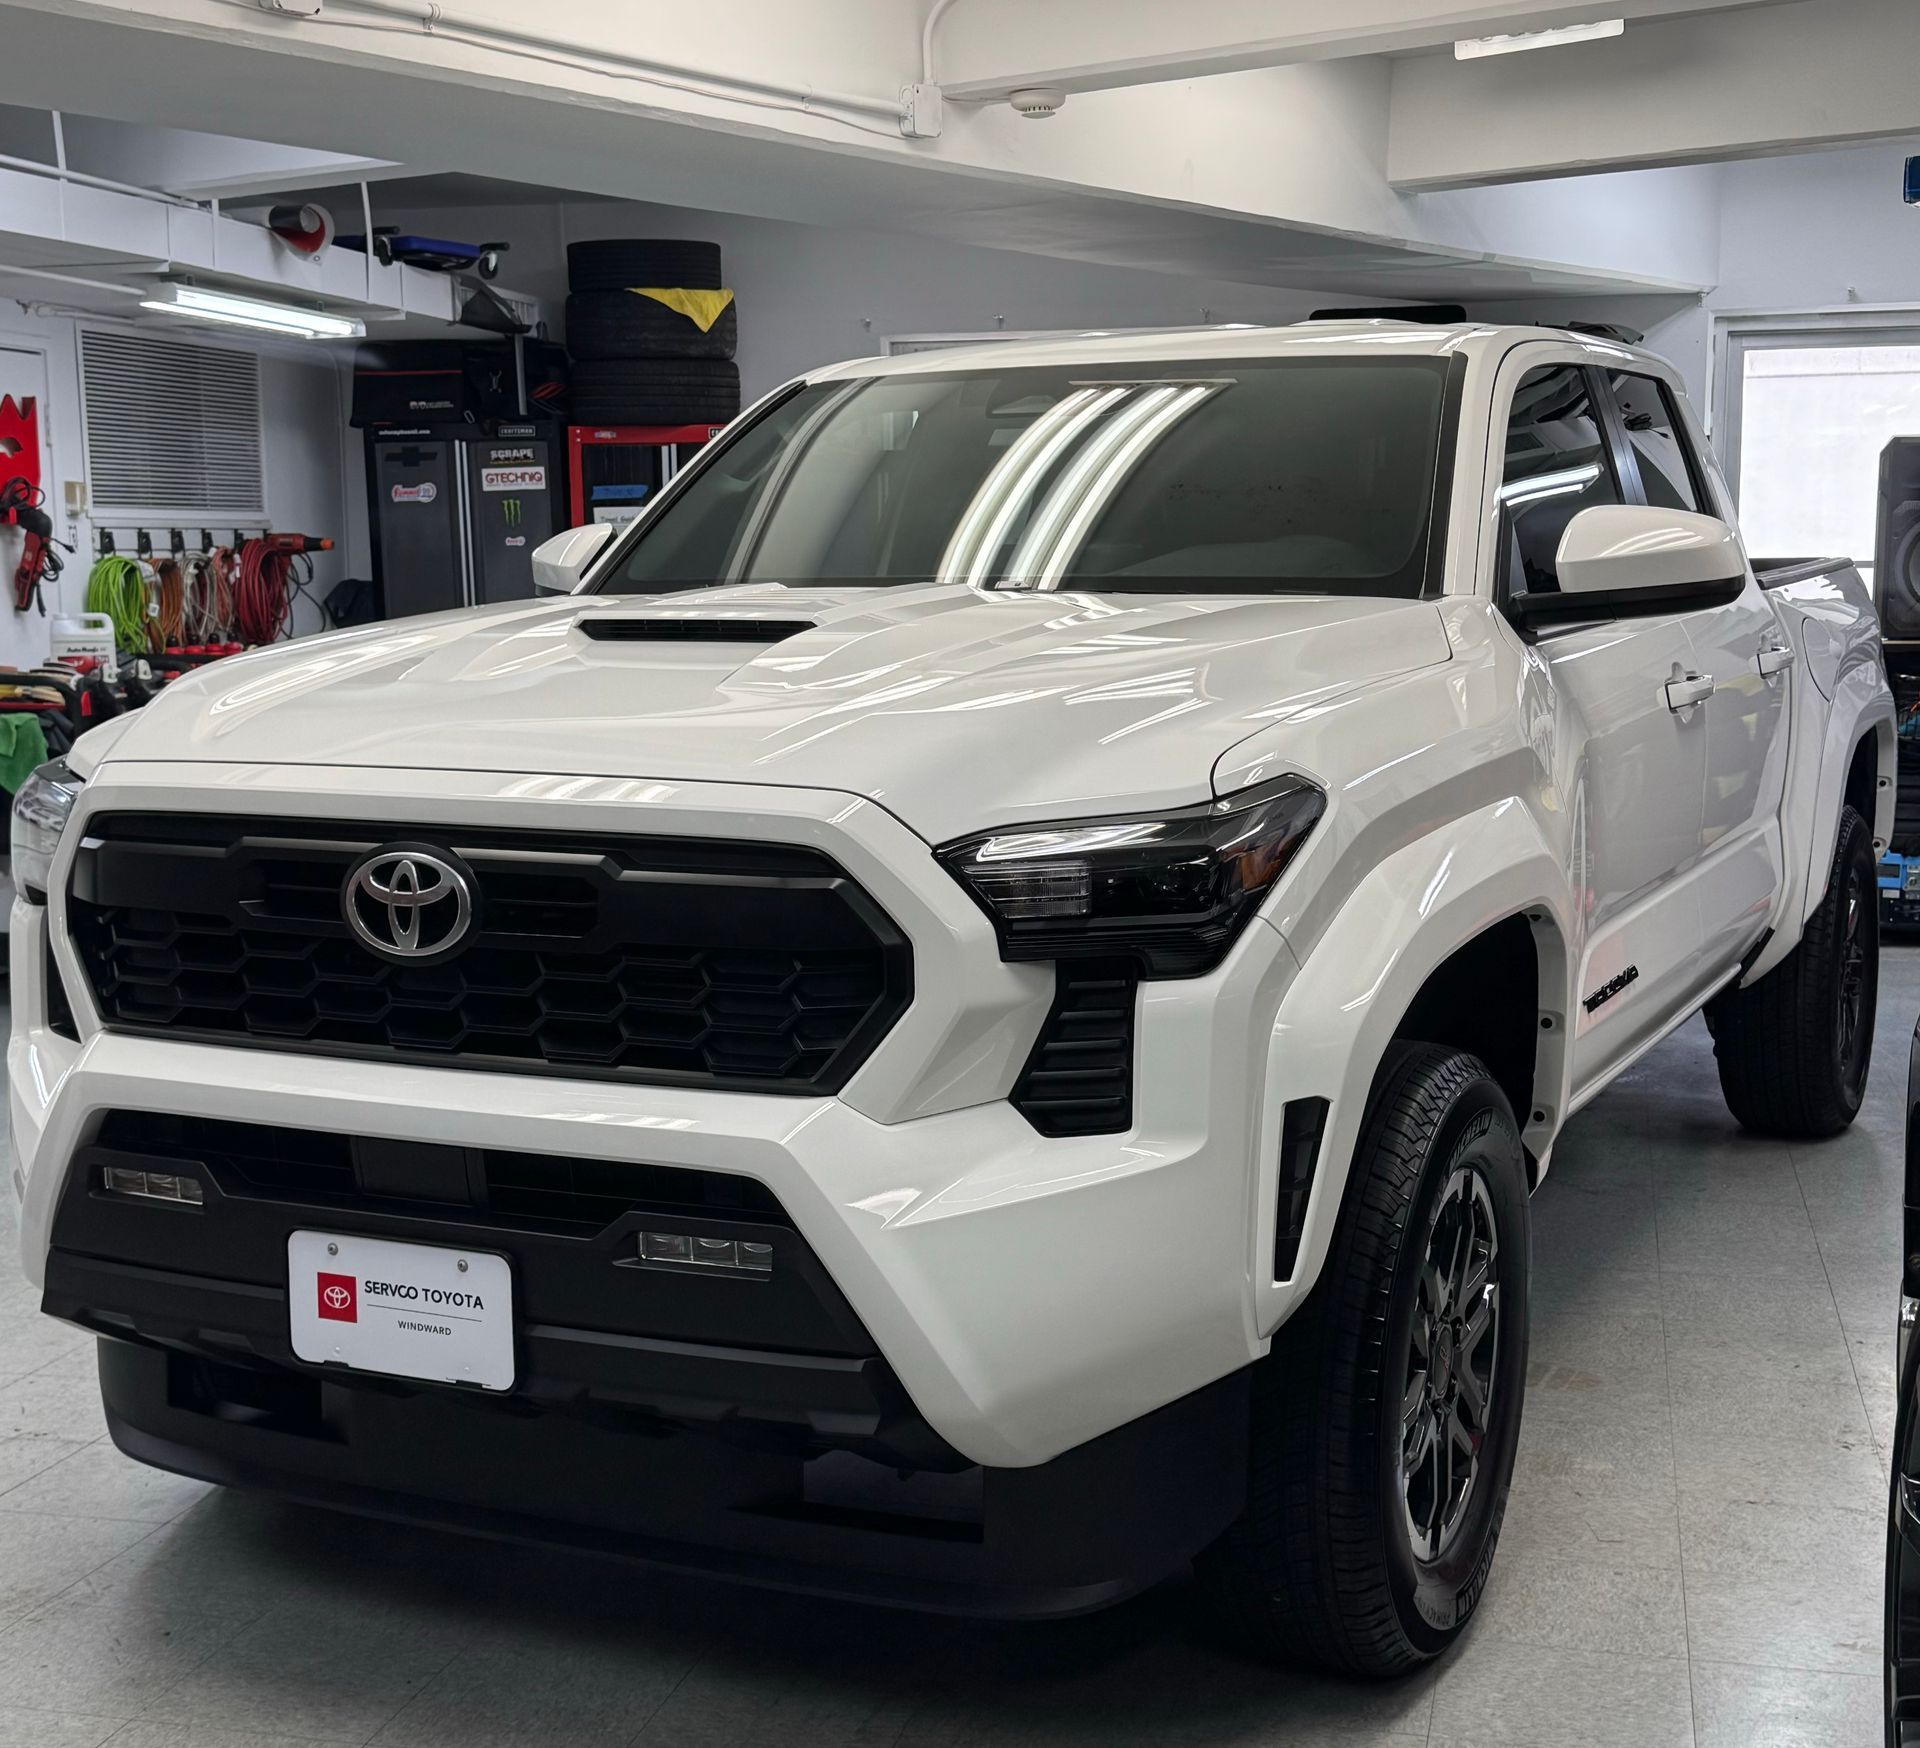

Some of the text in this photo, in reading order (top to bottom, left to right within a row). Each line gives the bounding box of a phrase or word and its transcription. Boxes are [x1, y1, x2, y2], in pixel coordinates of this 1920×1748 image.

[489, 448, 534, 461] SCRAPE
[485, 472, 543, 484] GTECHNIQ
[1446, 1110, 1493, 1176] MICHELIN
[364, 1280, 484, 1310] SERVCO TOYOTA
[398, 1321, 451, 1335] WINDWARD
